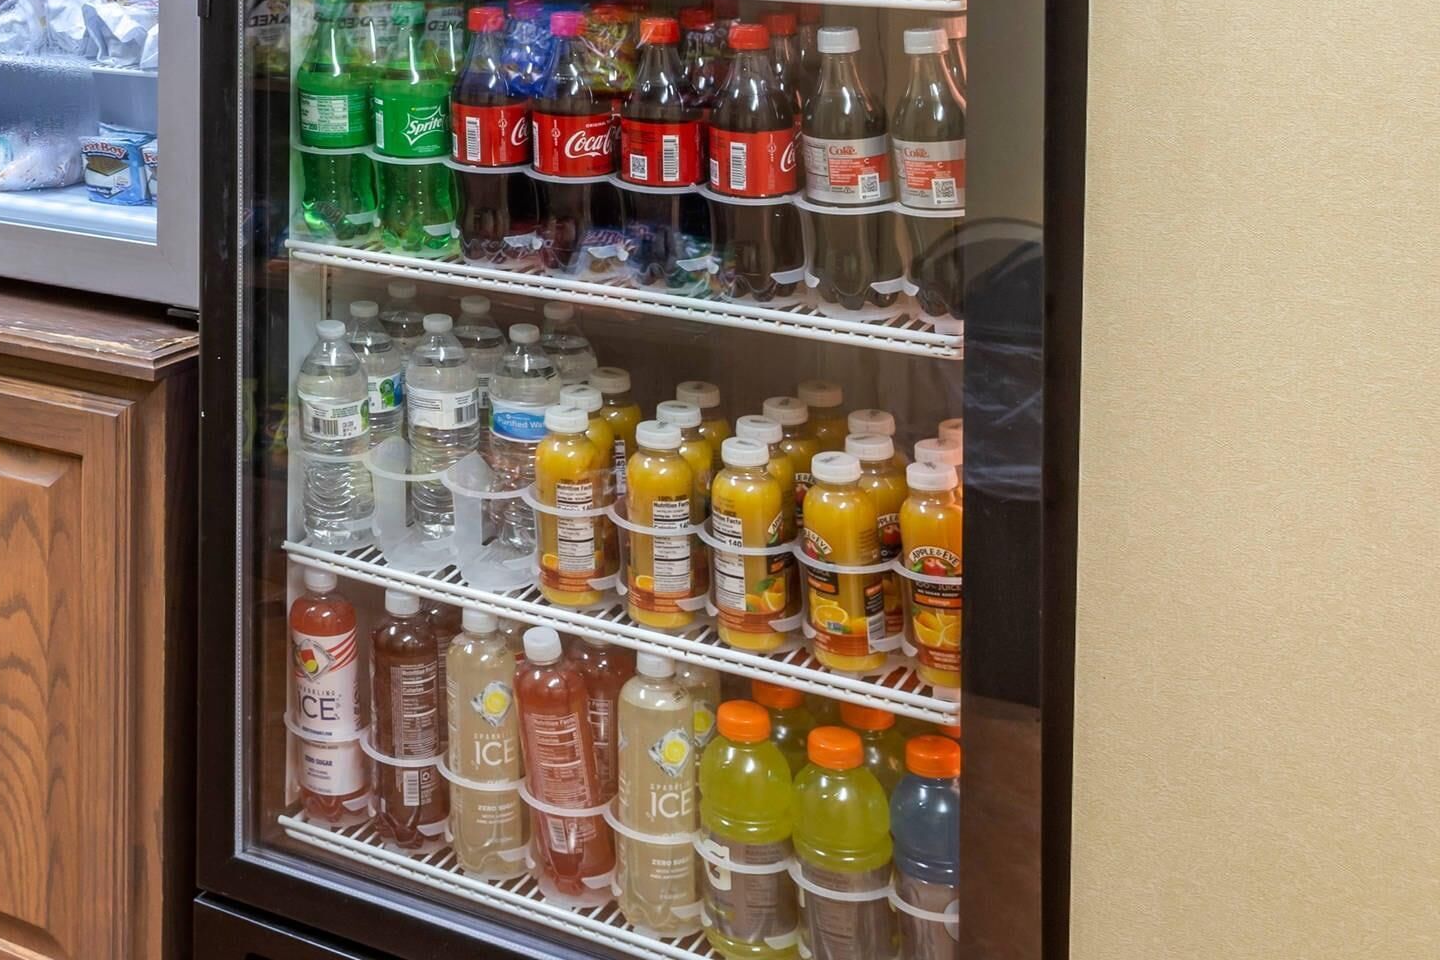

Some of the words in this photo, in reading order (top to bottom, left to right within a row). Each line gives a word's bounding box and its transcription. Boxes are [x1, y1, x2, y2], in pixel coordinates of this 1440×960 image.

[407, 116, 442, 135] Sprite
[912, 548, 935, 562] APPLE
[942, 551, 959, 566] EVE
[297, 691, 337, 722] ICE
[474, 739, 515, 767] ICE
[650, 787, 693, 819] ICE
